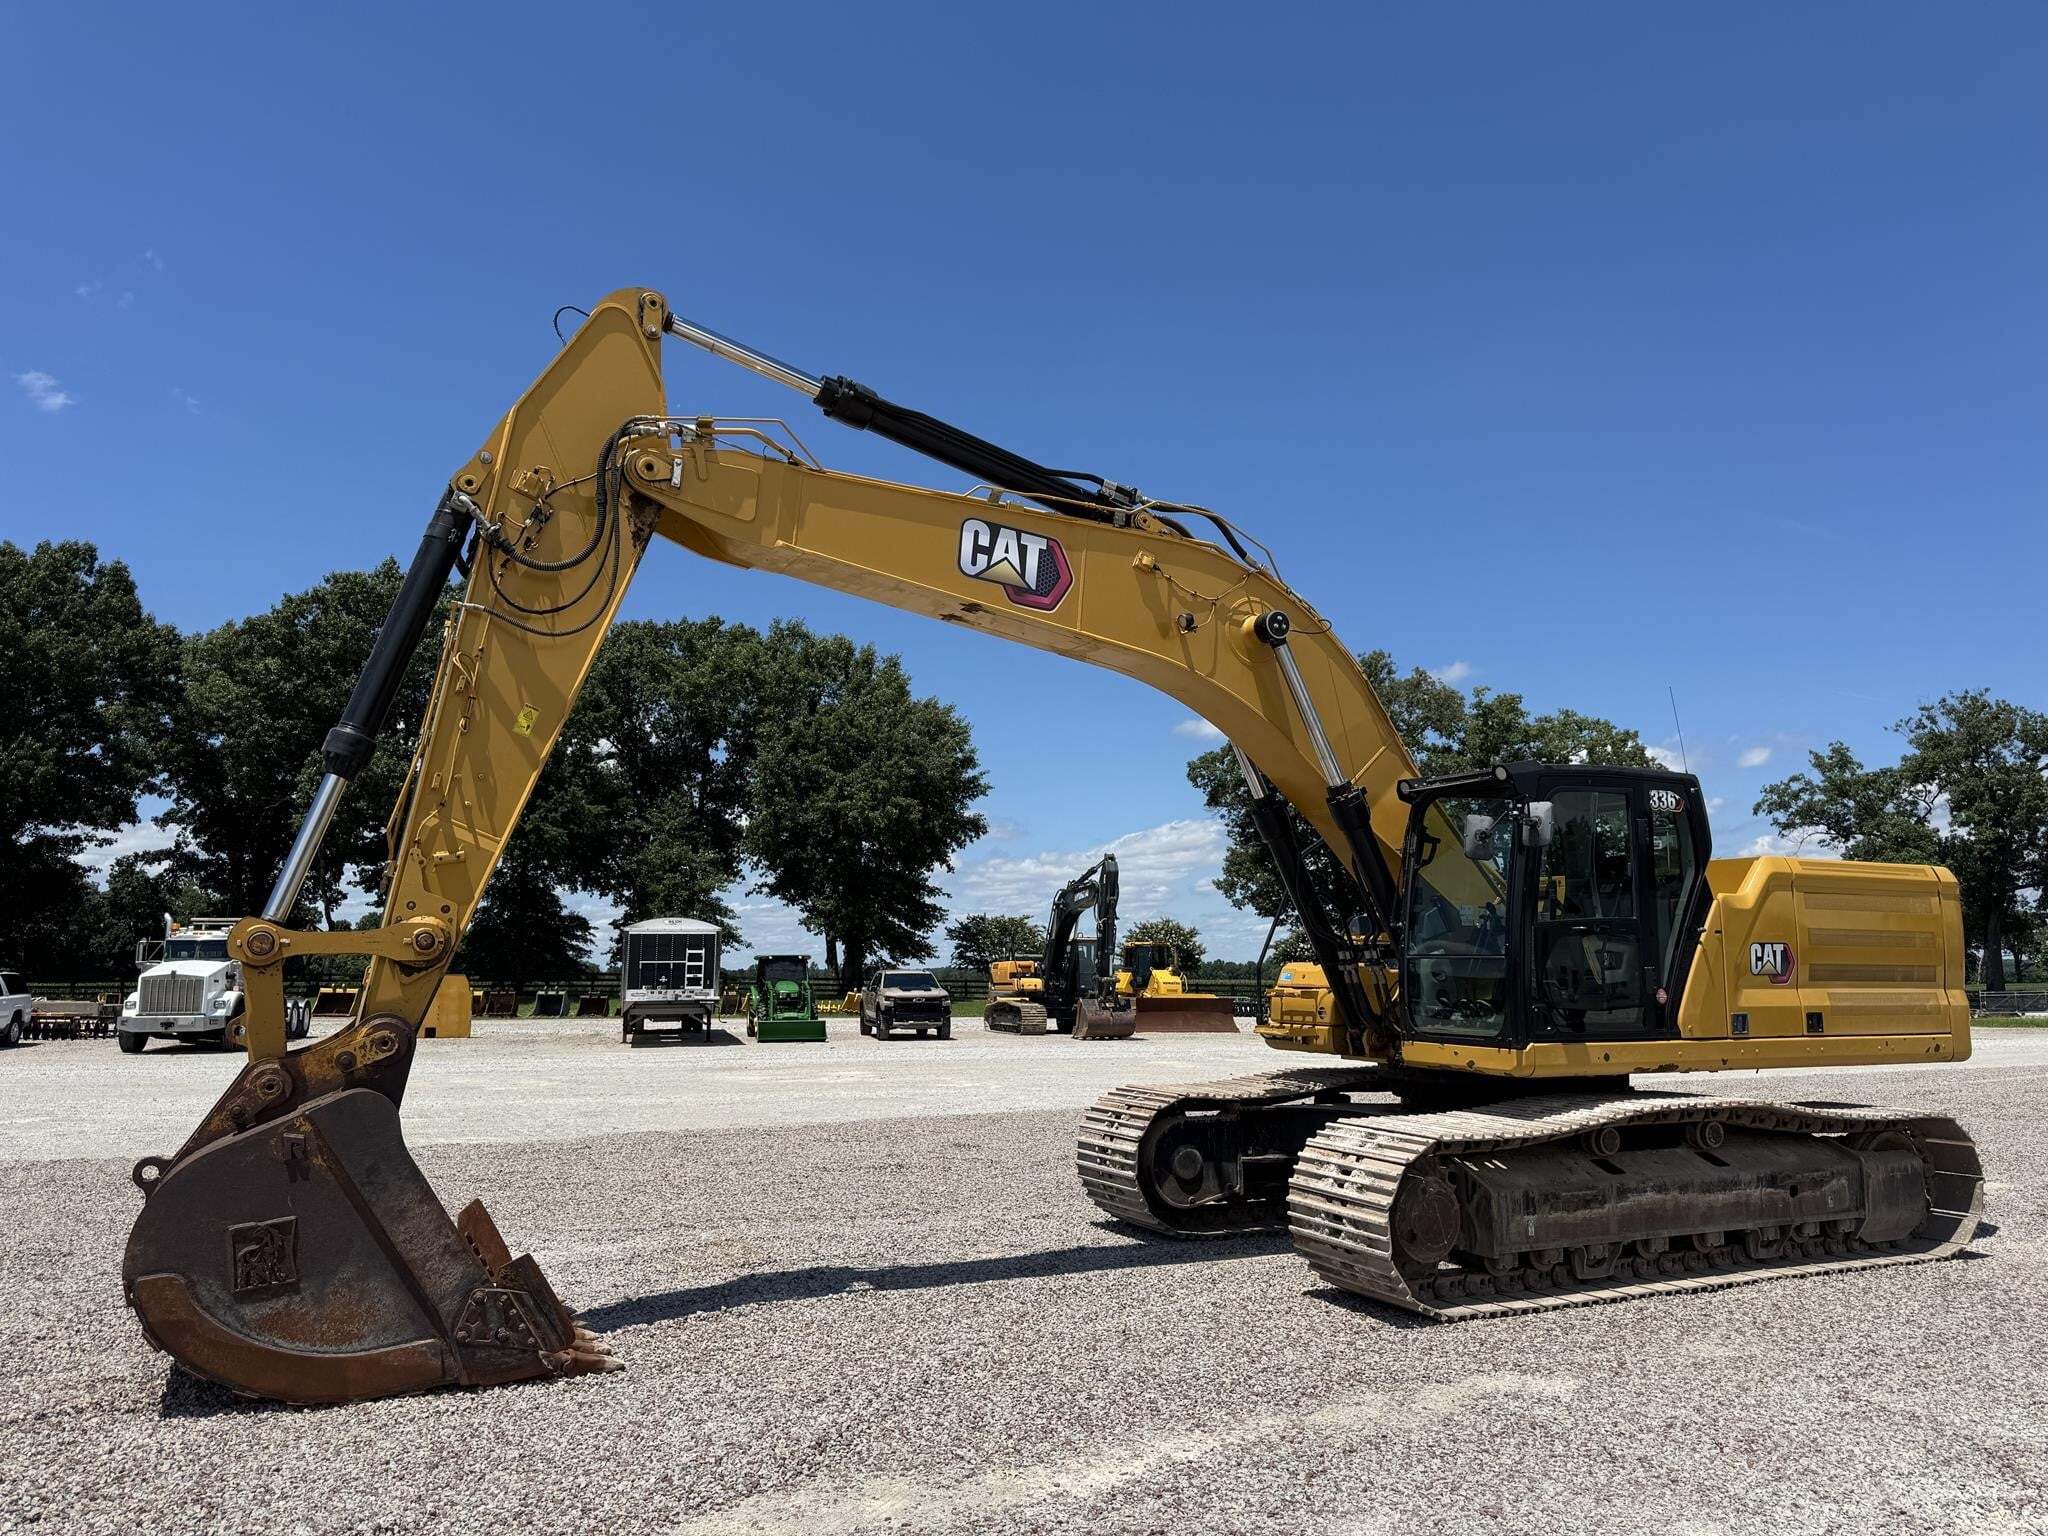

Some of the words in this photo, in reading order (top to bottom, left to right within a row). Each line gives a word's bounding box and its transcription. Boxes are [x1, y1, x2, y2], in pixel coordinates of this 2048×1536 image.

[960, 519, 1048, 591] CAT
[1651, 790, 1676, 809] 336
[1750, 943, 1784, 975] CAT
